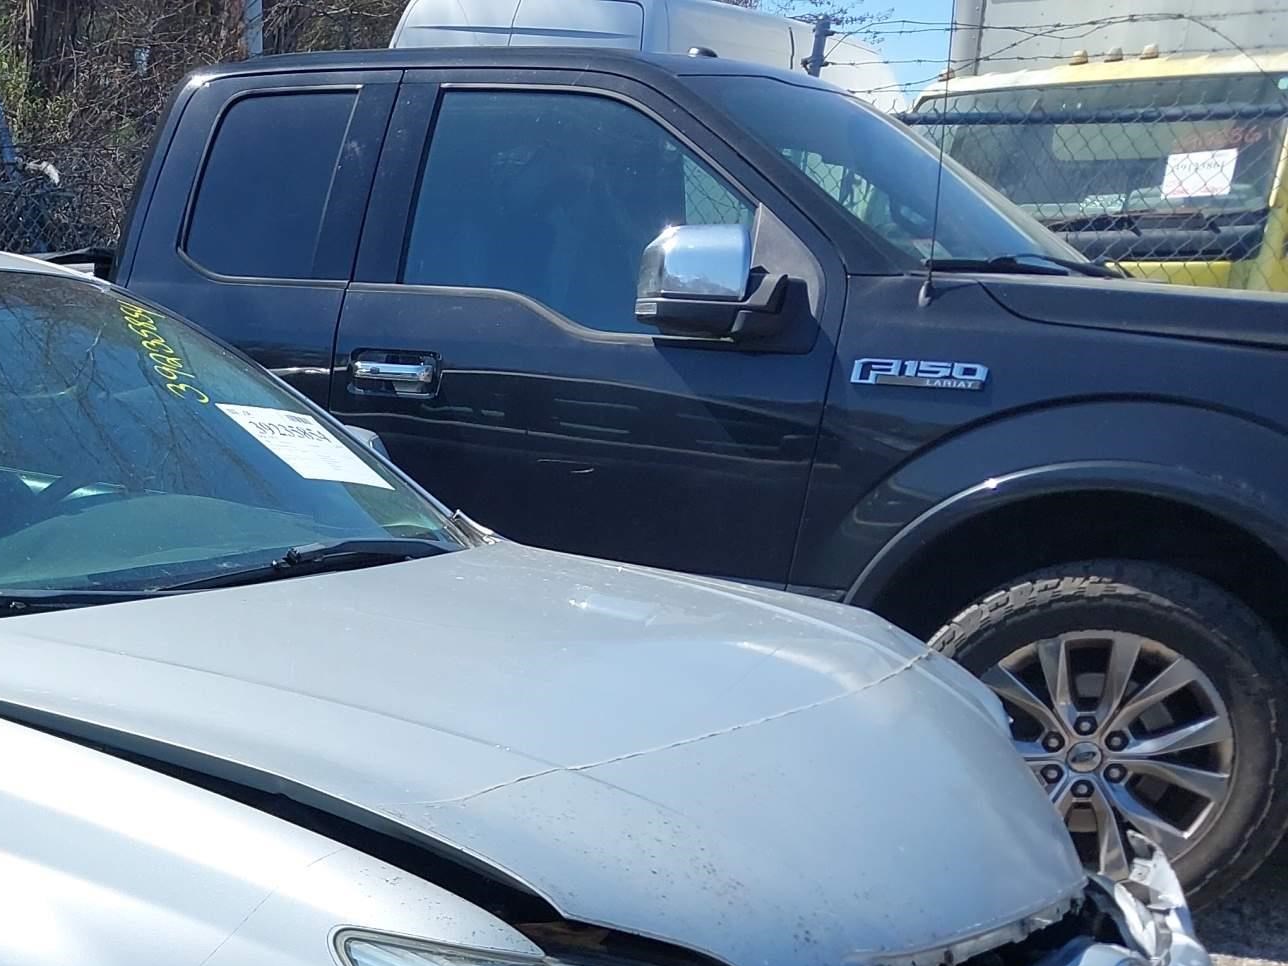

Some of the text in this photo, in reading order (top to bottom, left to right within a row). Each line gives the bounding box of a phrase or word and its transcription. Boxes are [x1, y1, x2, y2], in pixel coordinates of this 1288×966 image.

[116, 299, 209, 404] 39235854
[926, 379, 973, 389] LARIAT
[248, 420, 332, 443] 39235854
